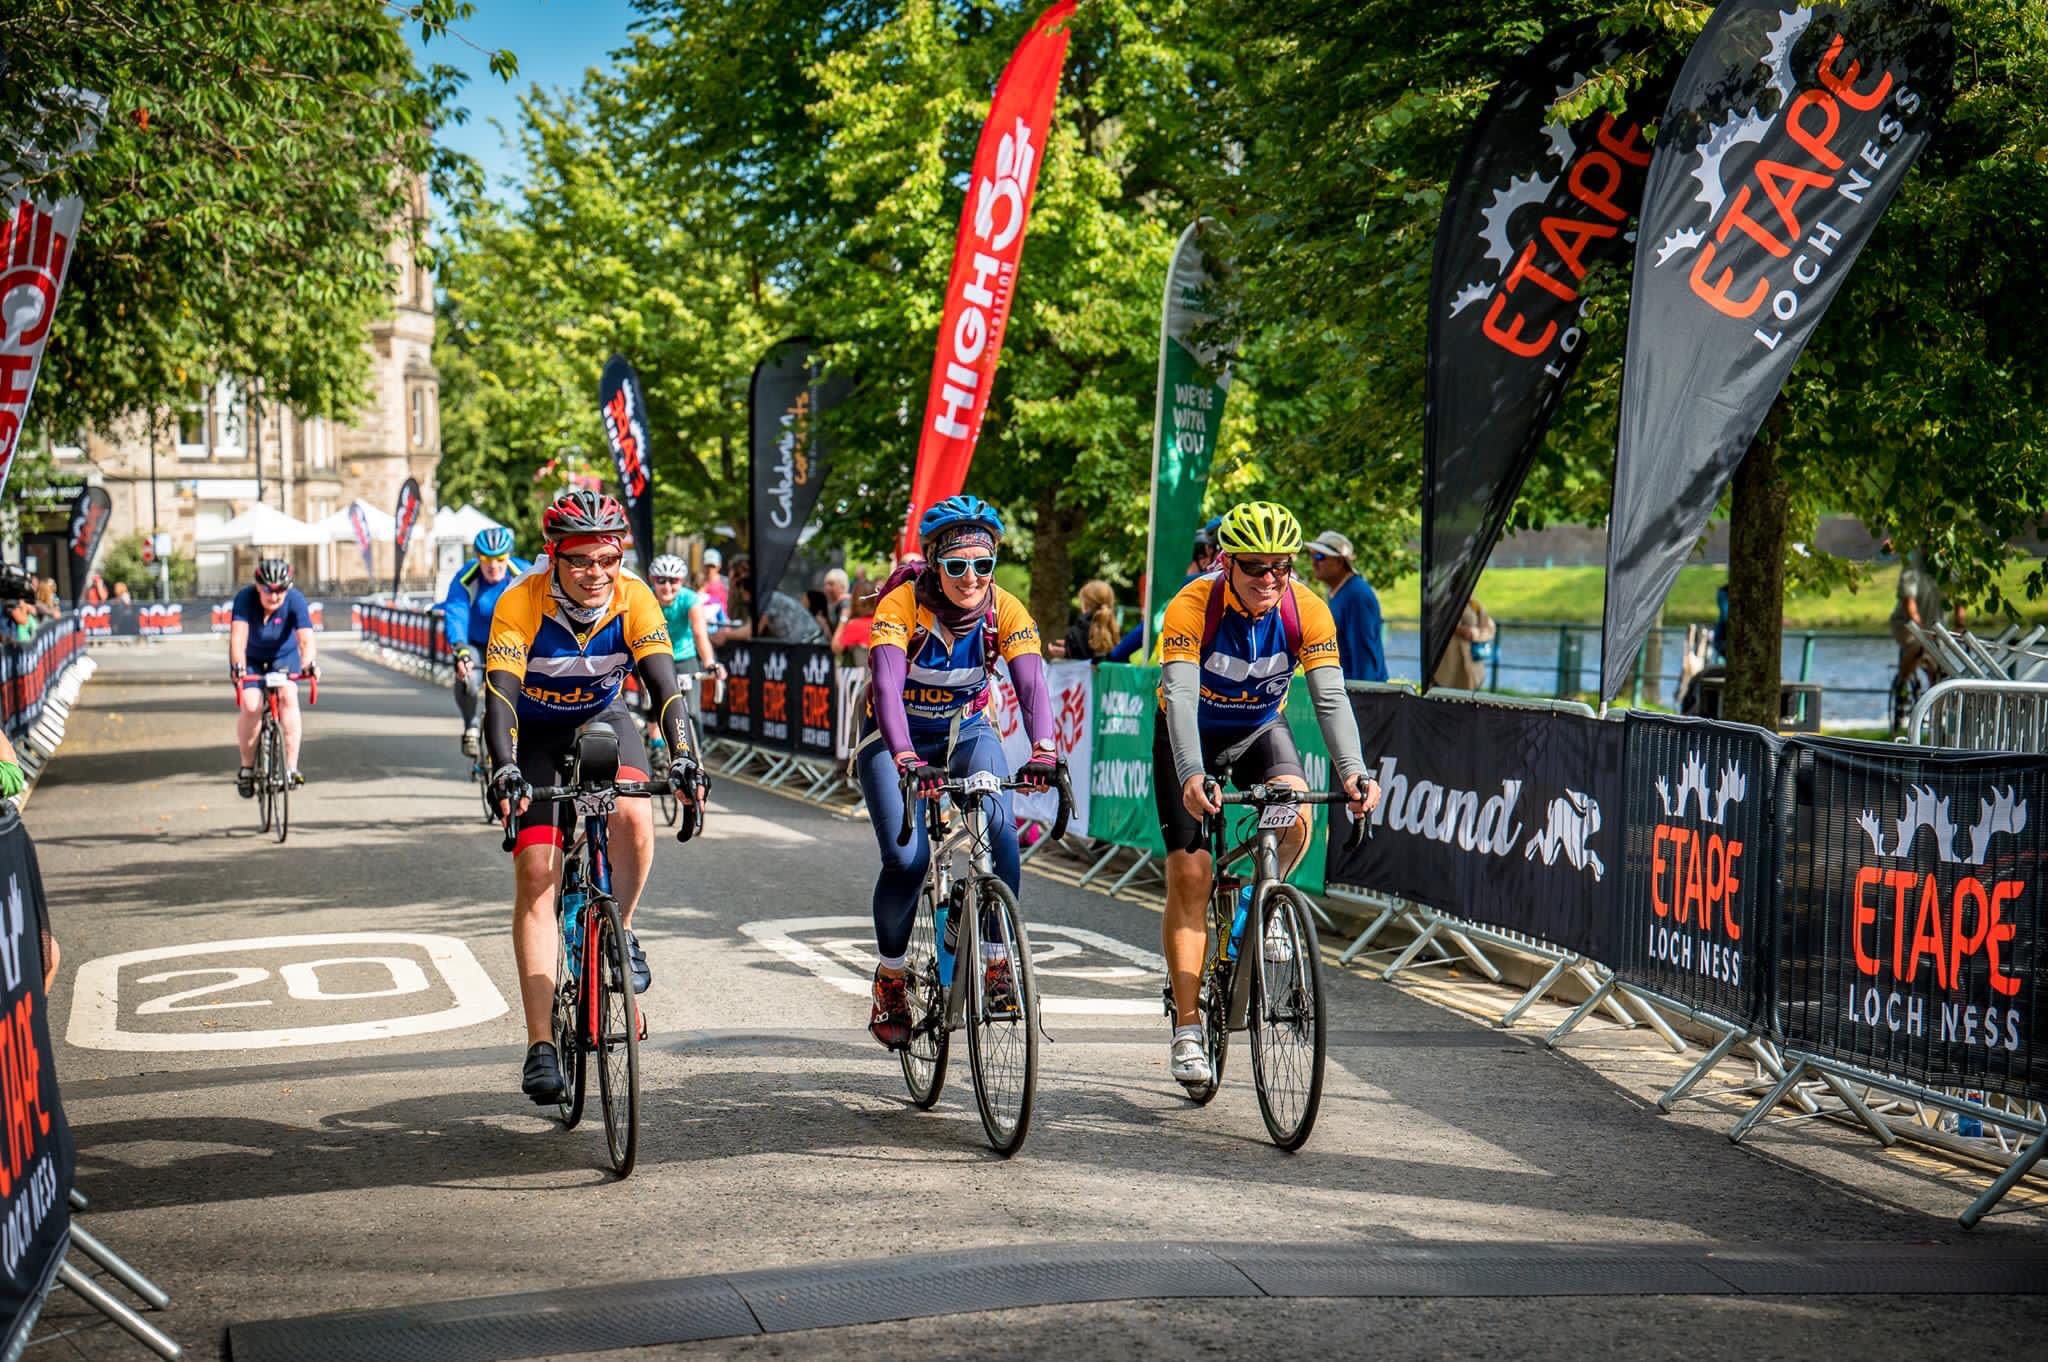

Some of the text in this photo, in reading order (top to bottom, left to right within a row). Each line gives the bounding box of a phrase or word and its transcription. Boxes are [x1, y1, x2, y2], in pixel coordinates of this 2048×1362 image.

[1688, 33, 1893, 319] ETAPE
[1481, 111, 1651, 358] ETAPE
[1753, 84, 1921, 351] LOCH NESS
[1172, 406, 1206, 433] WITH
[1175, 383, 1213, 410] WE'RE
[767, 414, 795, 529] Caledonin
[1175, 431, 1205, 455] YOU
[1163, 634, 1190, 648] ands
[521, 686, 595, 704] ands
[902, 688, 954, 703] ands
[1262, 815, 1295, 826] 4017
[1346, 756, 1523, 857] hand
[1652, 824, 1744, 940] ETAPE
[1649, 924, 1740, 986] LOCH NESS
[1853, 866, 2025, 996] ETAPE
[135, 957, 431, 1014] 20
[1849, 984, 2020, 1050] LOCH NESS
[0, 991, 50, 1198] TAPE
[2, 1152, 56, 1280] LOCH NESS
